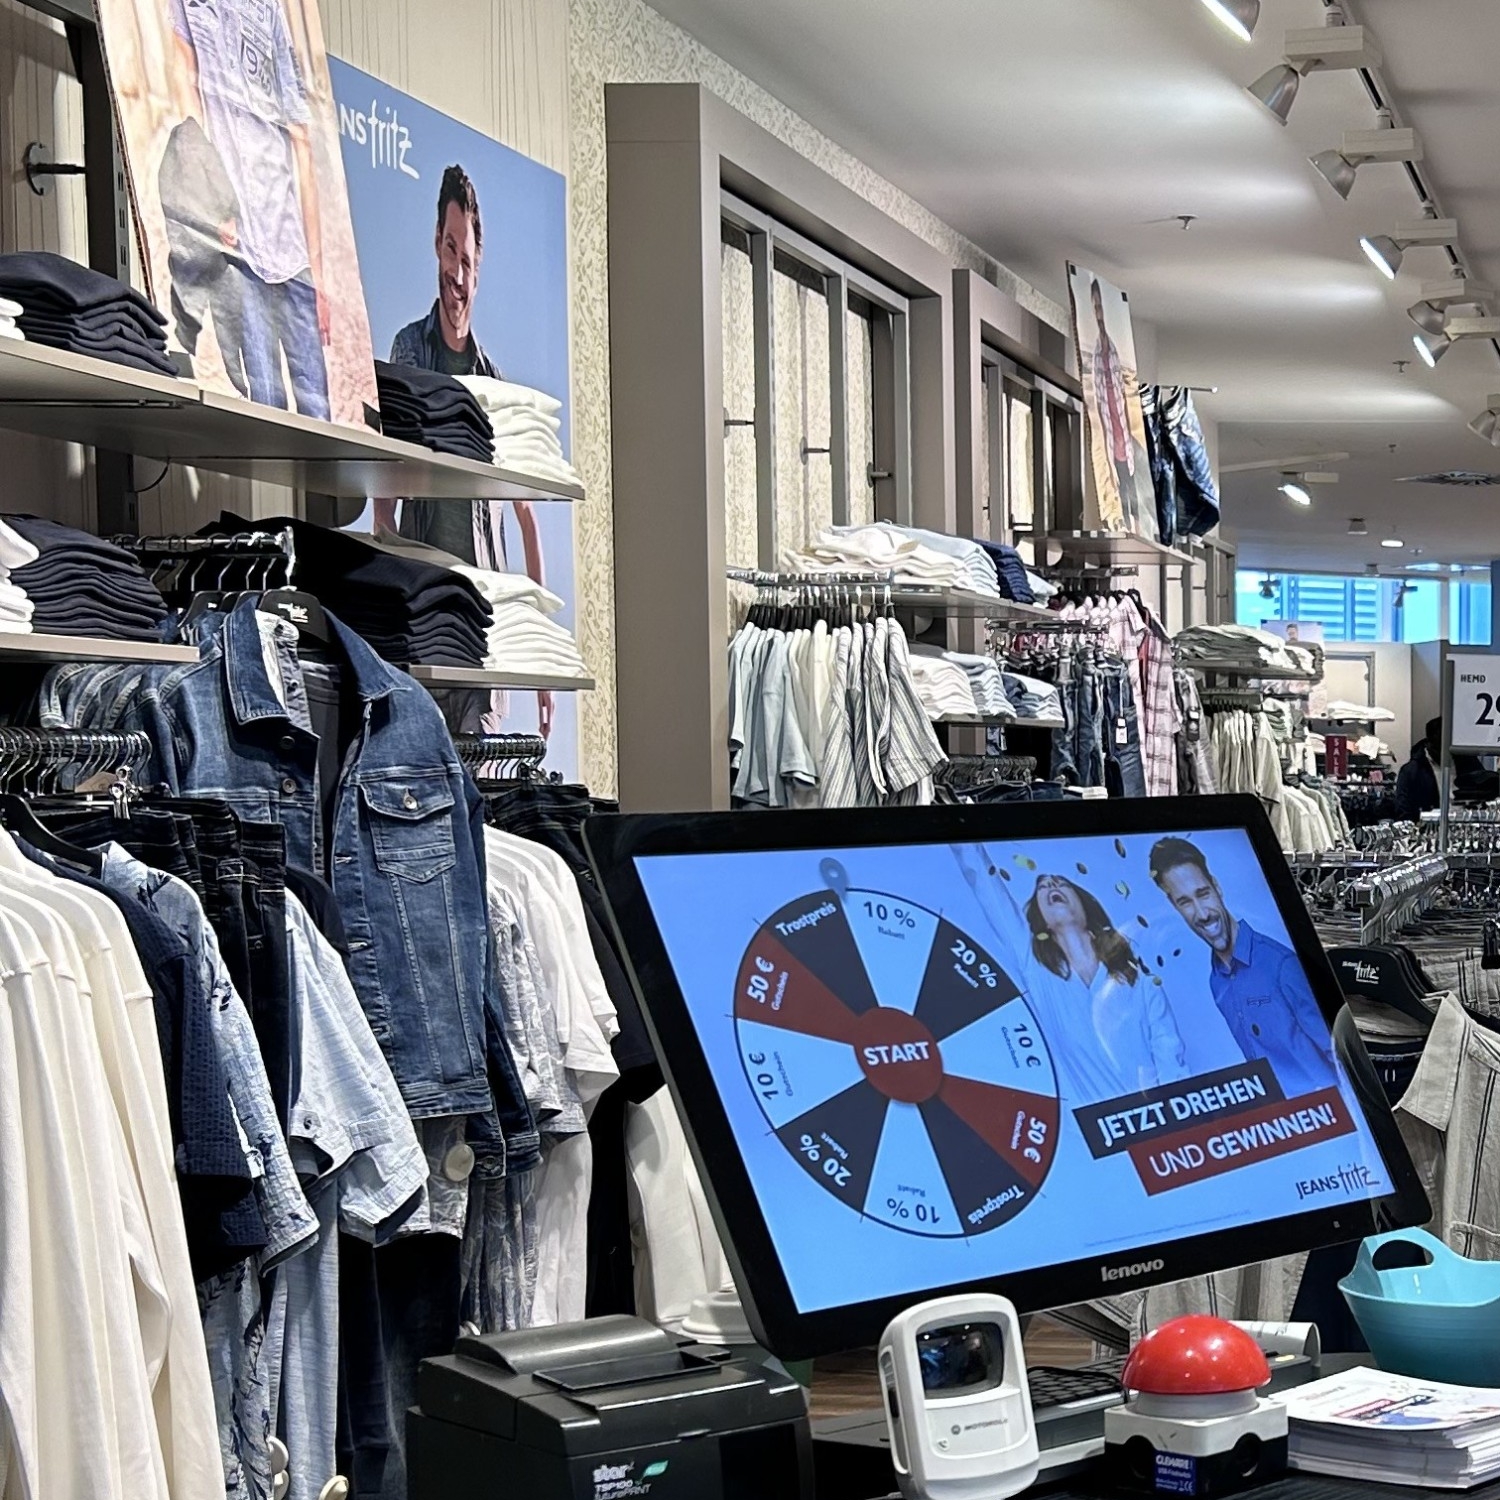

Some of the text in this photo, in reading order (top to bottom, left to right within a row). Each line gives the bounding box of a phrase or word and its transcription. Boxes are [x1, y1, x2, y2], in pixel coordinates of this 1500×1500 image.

[338, 103, 367, 145] NS
[1460, 674, 1486, 683] HEMD
[775, 901, 837, 936] Trostpreis
[863, 901, 916, 929] 10 %
[950, 939, 998, 988] 20 %
[747, 975, 770, 1004] 50
[1013, 1023, 1033, 1049] 10
[863, 1041, 930, 1067] START
[757, 1073, 779, 1101] 10
[1097, 1074, 1267, 1148] JETZT DREHEN
[1027, 1117, 1047, 1145] 50
[1150, 1103, 1338, 1178] UND GEWINNEN!
[823, 1158, 852, 1187] 20
[887, 1198, 941, 1224] 10 %
[967, 1185, 1025, 1225] Trostpreis
[1101, 1258, 1165, 1282] lenovo
